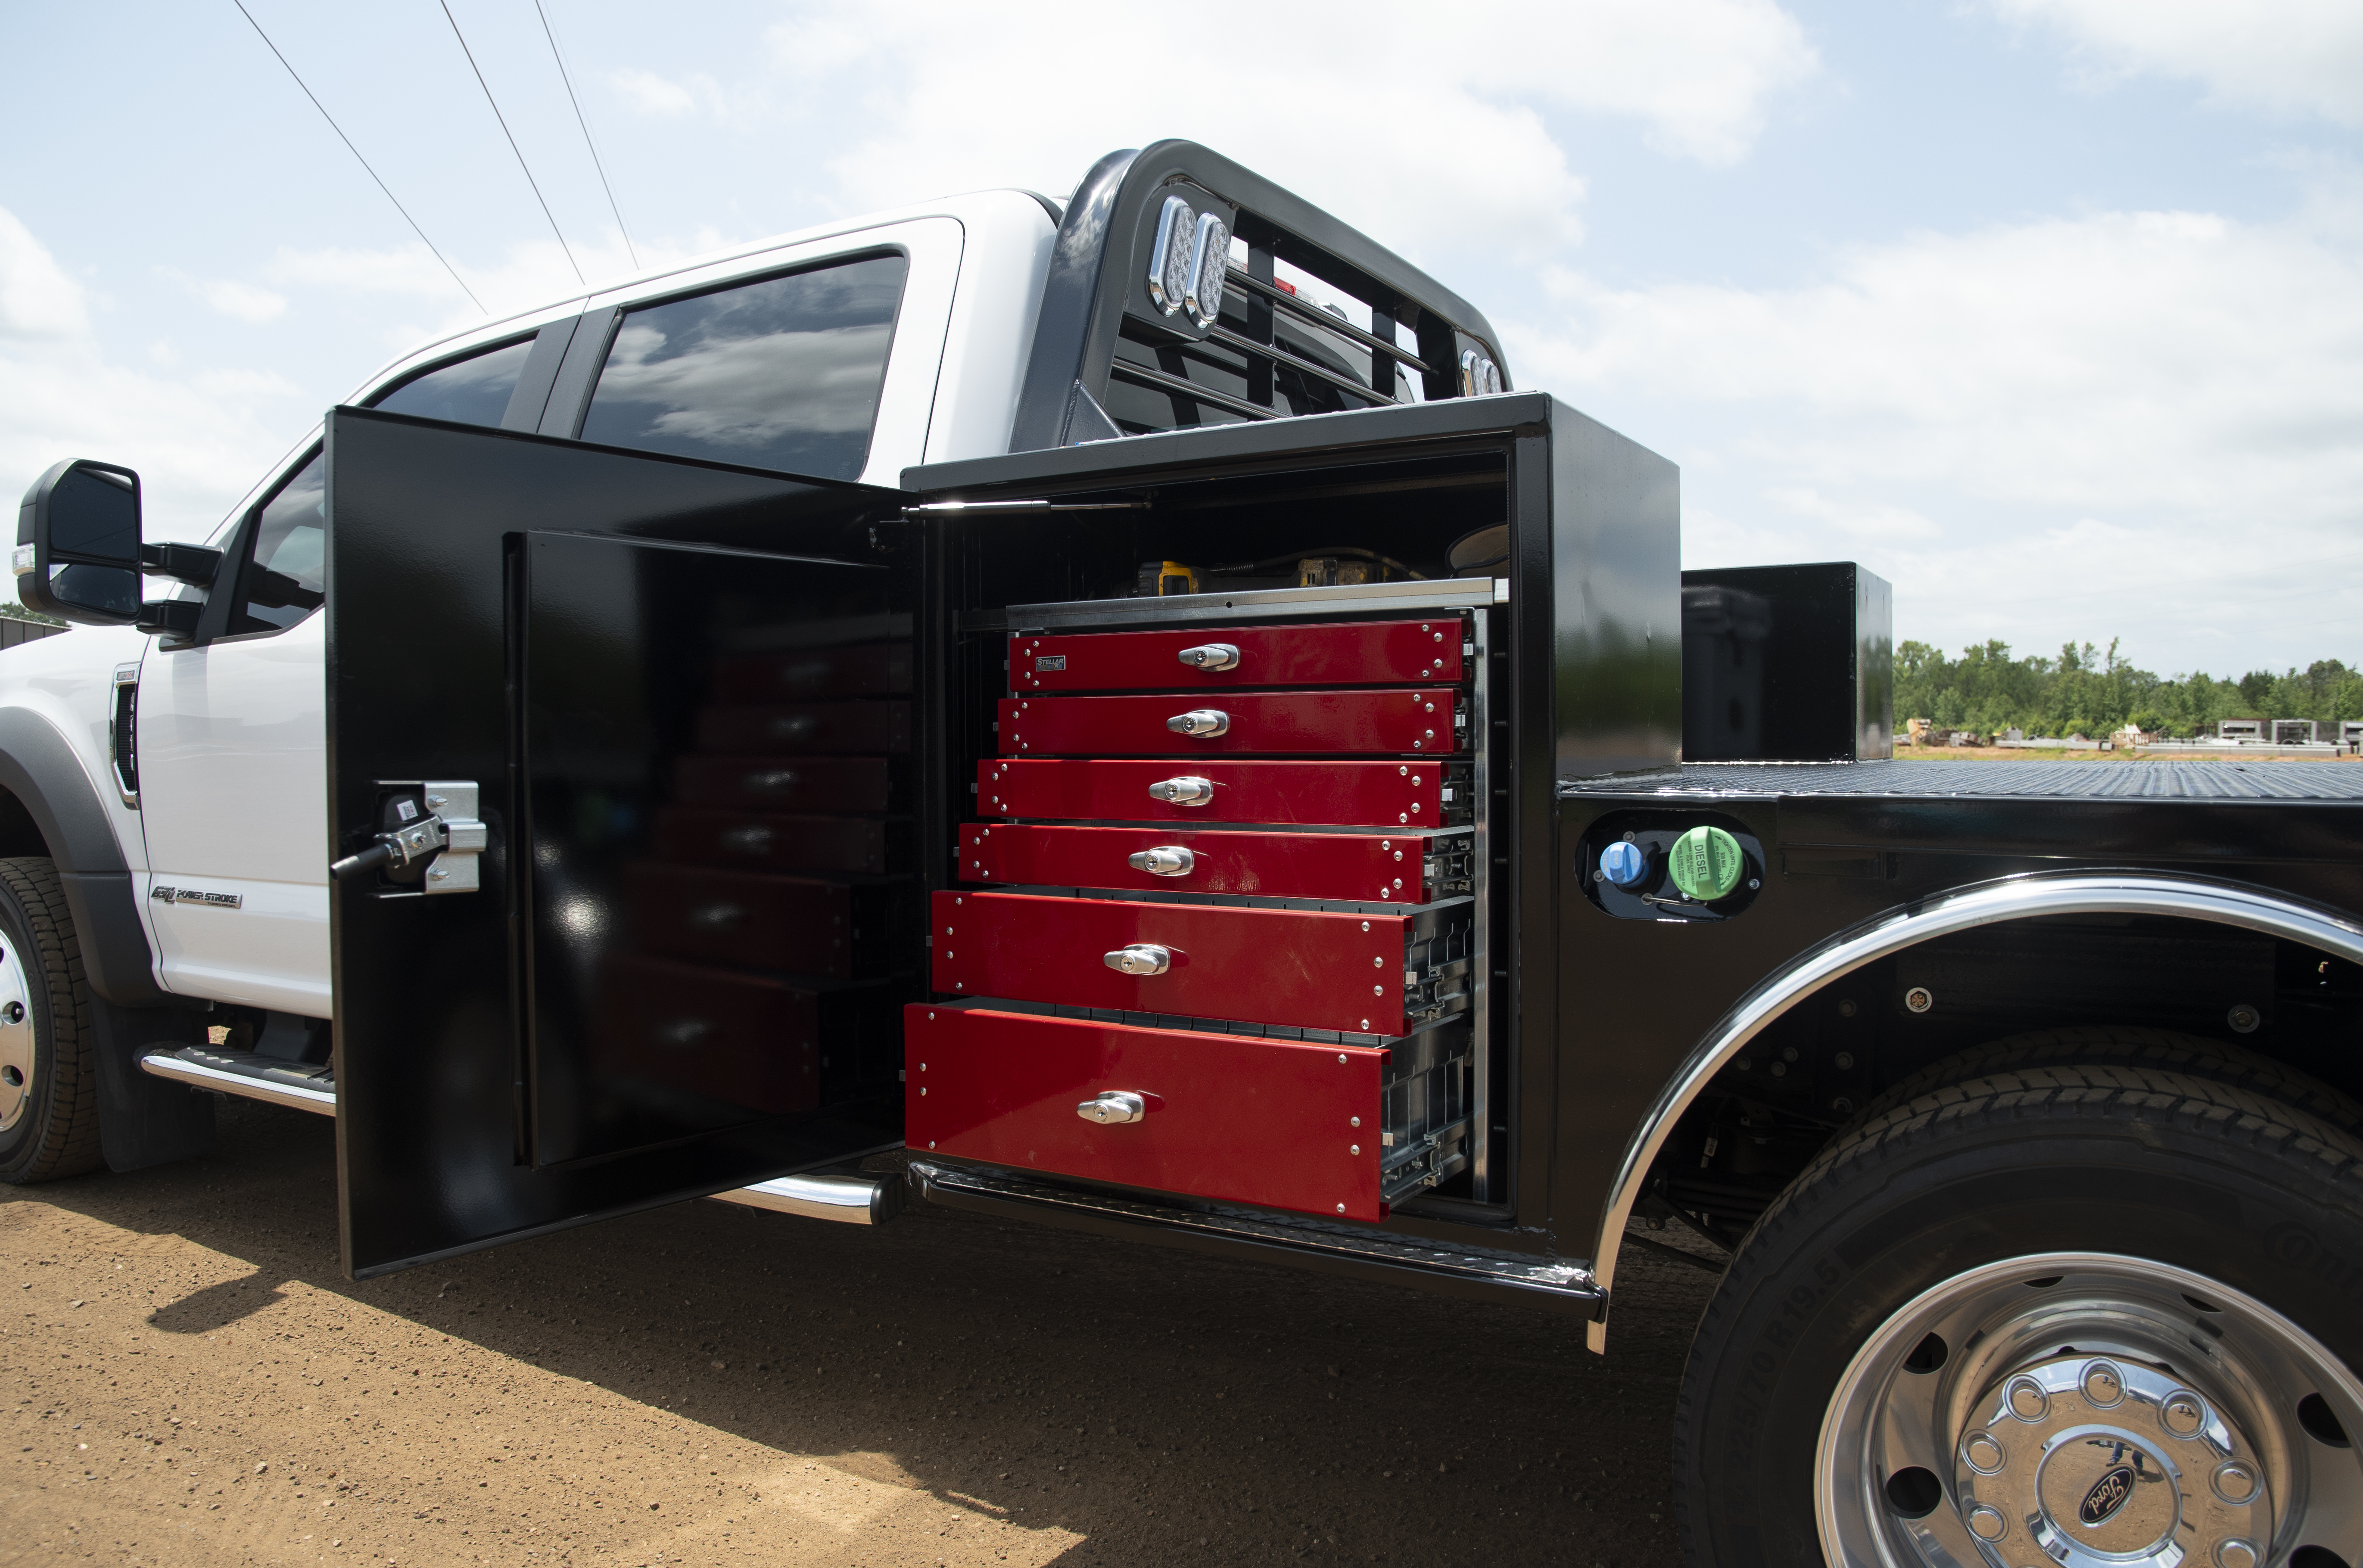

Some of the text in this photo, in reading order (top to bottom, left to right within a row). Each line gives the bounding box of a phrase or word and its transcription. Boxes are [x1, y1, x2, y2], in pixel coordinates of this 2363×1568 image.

[118, 671, 133, 680] STX
[1722, 838, 1734, 855] TIGHTEN
[1694, 845, 1707, 879] DIESEL
[1725, 867, 1734, 881] CLICKS
[177, 890, 204, 900] POWER
[205, 893, 238, 904] STROKE
[2263, 1220, 2363, 1308] Cont
[1729, 1350, 1776, 1473] 225/70
[2088, 1475, 2124, 1515] Ford
